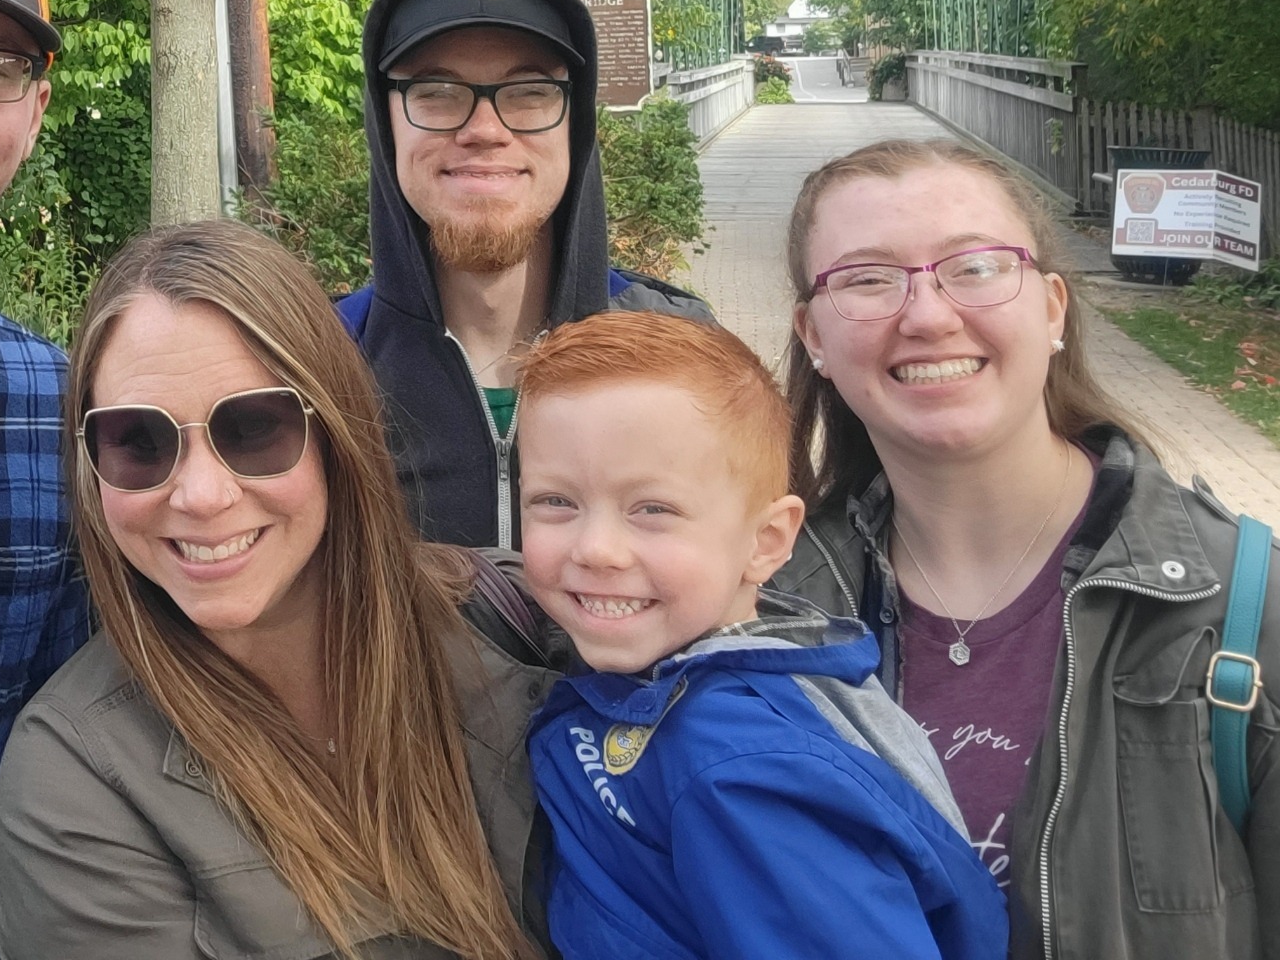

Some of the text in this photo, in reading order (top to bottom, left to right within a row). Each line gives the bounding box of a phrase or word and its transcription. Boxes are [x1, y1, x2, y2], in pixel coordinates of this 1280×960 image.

[1171, 176, 1237, 195] Cedarburg
[1238, 186, 1254, 198] FD
[1159, 233, 1191, 244] JOIN
[1194, 234, 1222, 247] OUR
[1223, 238, 1254, 257] TEAM
[944, 724, 1021, 760] you
